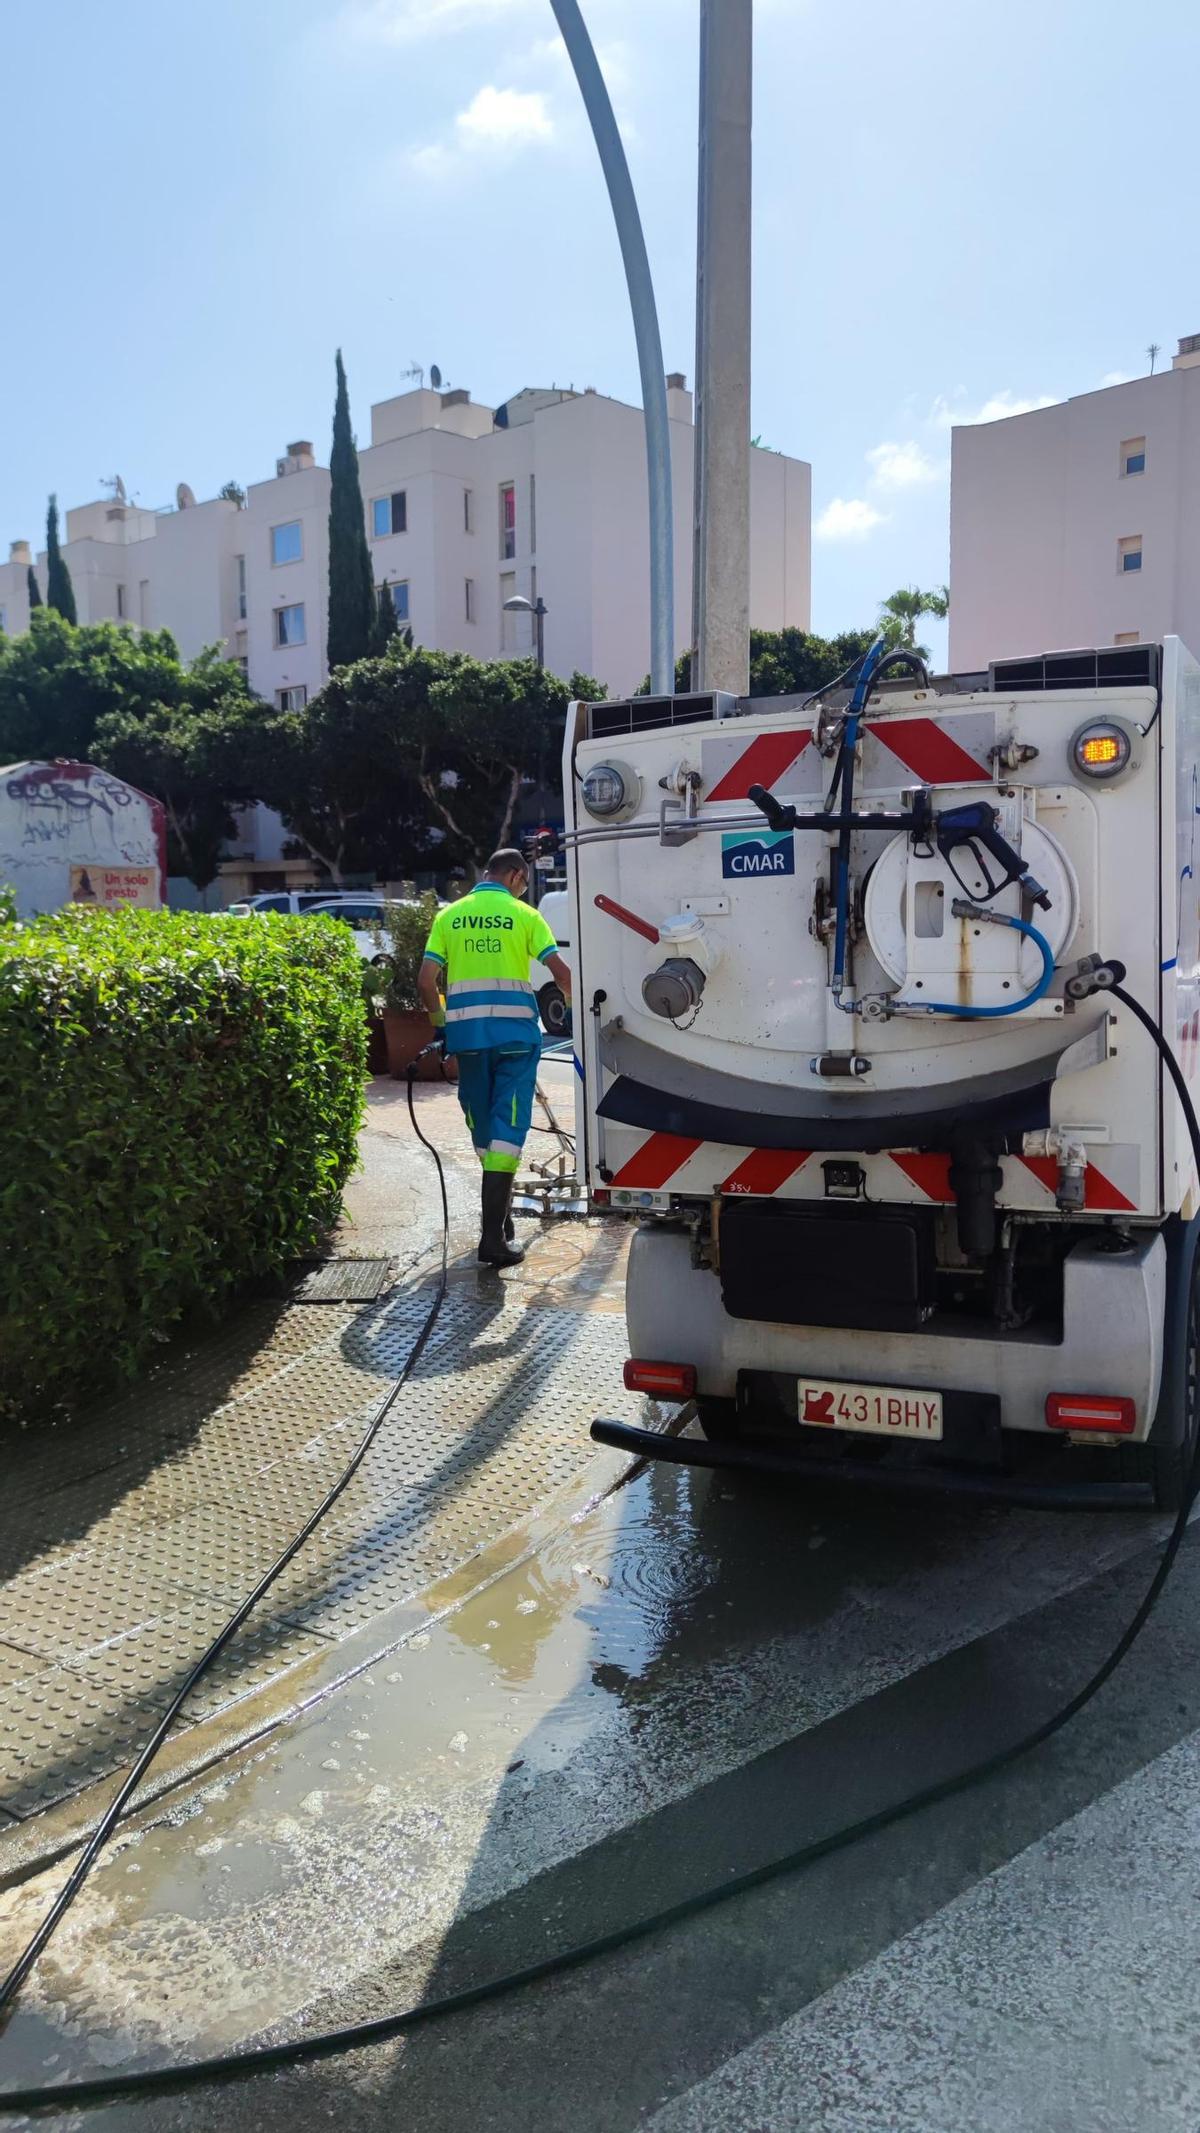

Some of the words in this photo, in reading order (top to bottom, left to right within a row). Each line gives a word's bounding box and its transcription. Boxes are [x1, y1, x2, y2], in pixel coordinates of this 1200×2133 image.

[731, 853, 785, 873] CMAR
[104, 873, 120, 885] Un
[126, 873, 149, 886] solo
[105, 887, 138, 901] gesto
[452, 915, 514, 931] eivissa
[464, 936, 502, 954] neta
